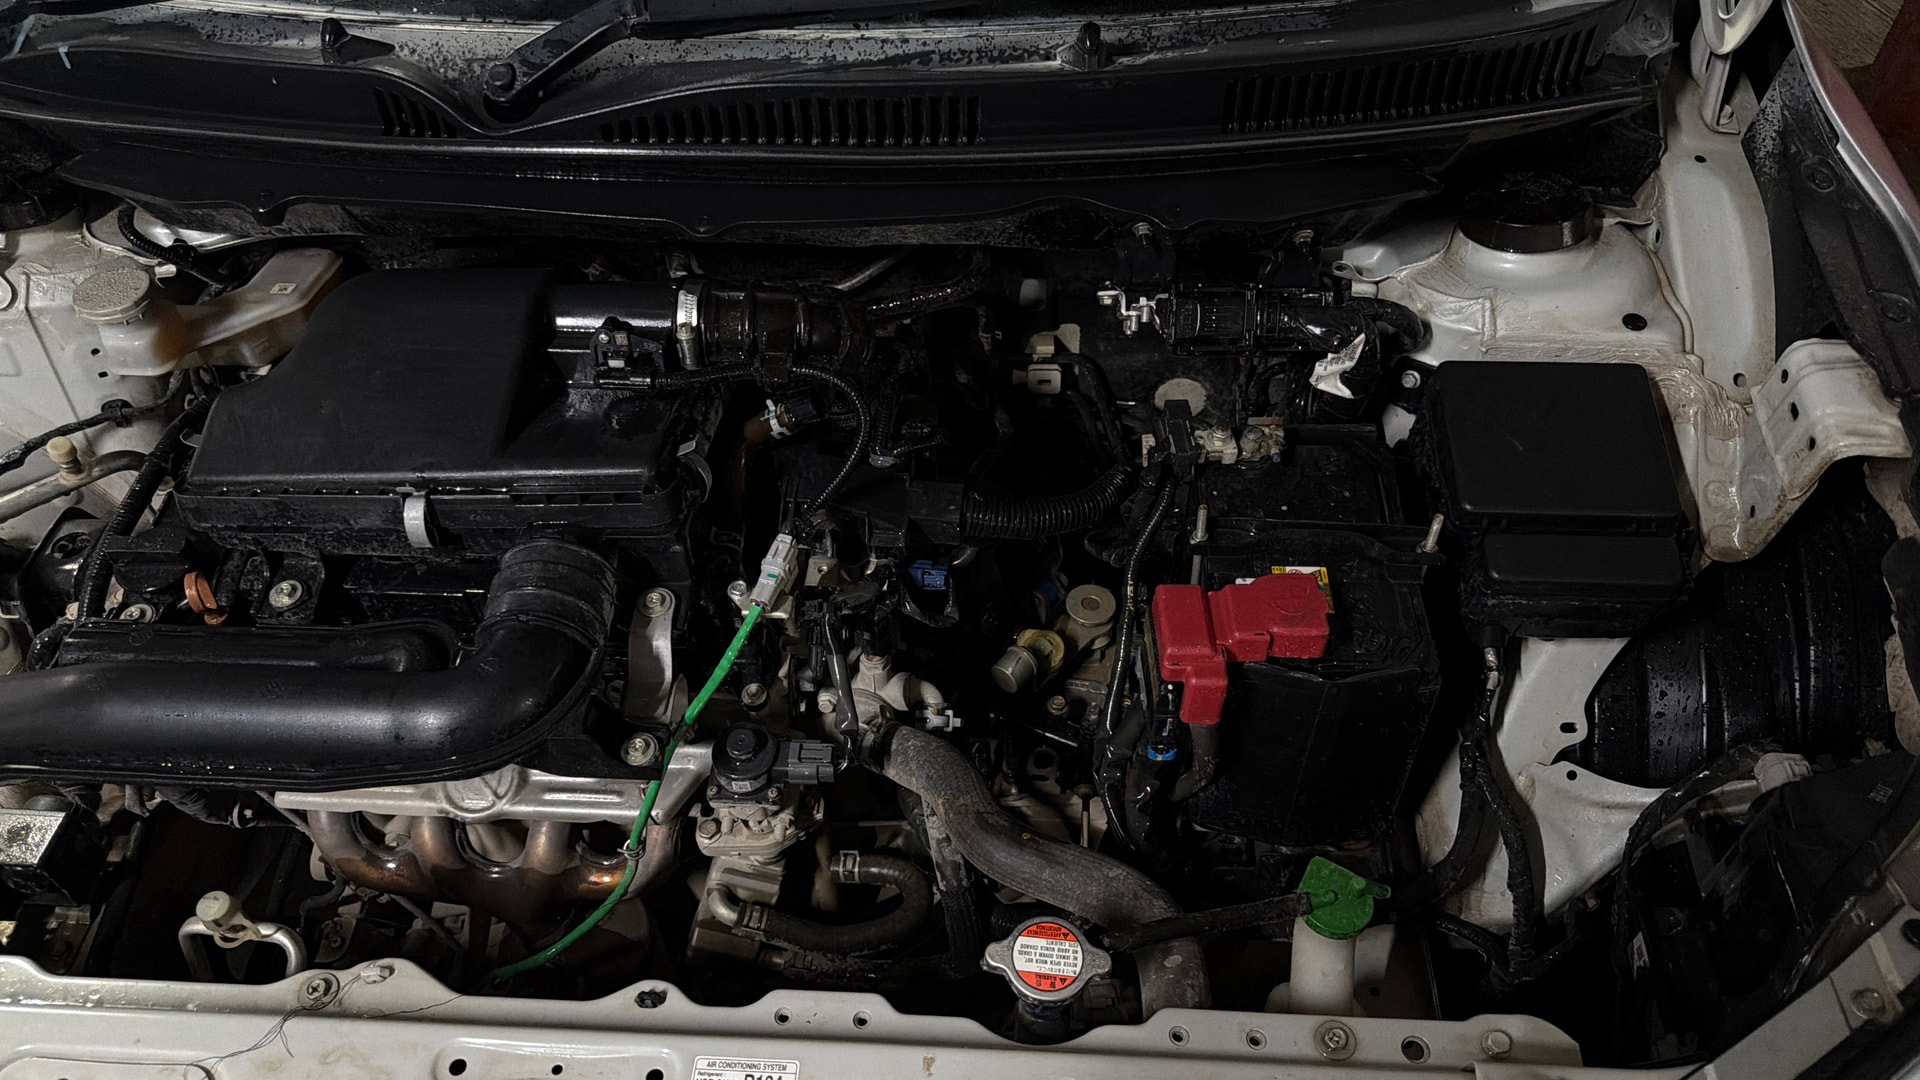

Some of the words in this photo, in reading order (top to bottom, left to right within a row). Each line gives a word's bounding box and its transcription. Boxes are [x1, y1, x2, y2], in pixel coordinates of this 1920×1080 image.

[1055, 953, 1071, 961] JAMAIS
[718, 1061, 762, 1070] CONDITIONING
[762, 1063, 787, 1071] SYSTEM
